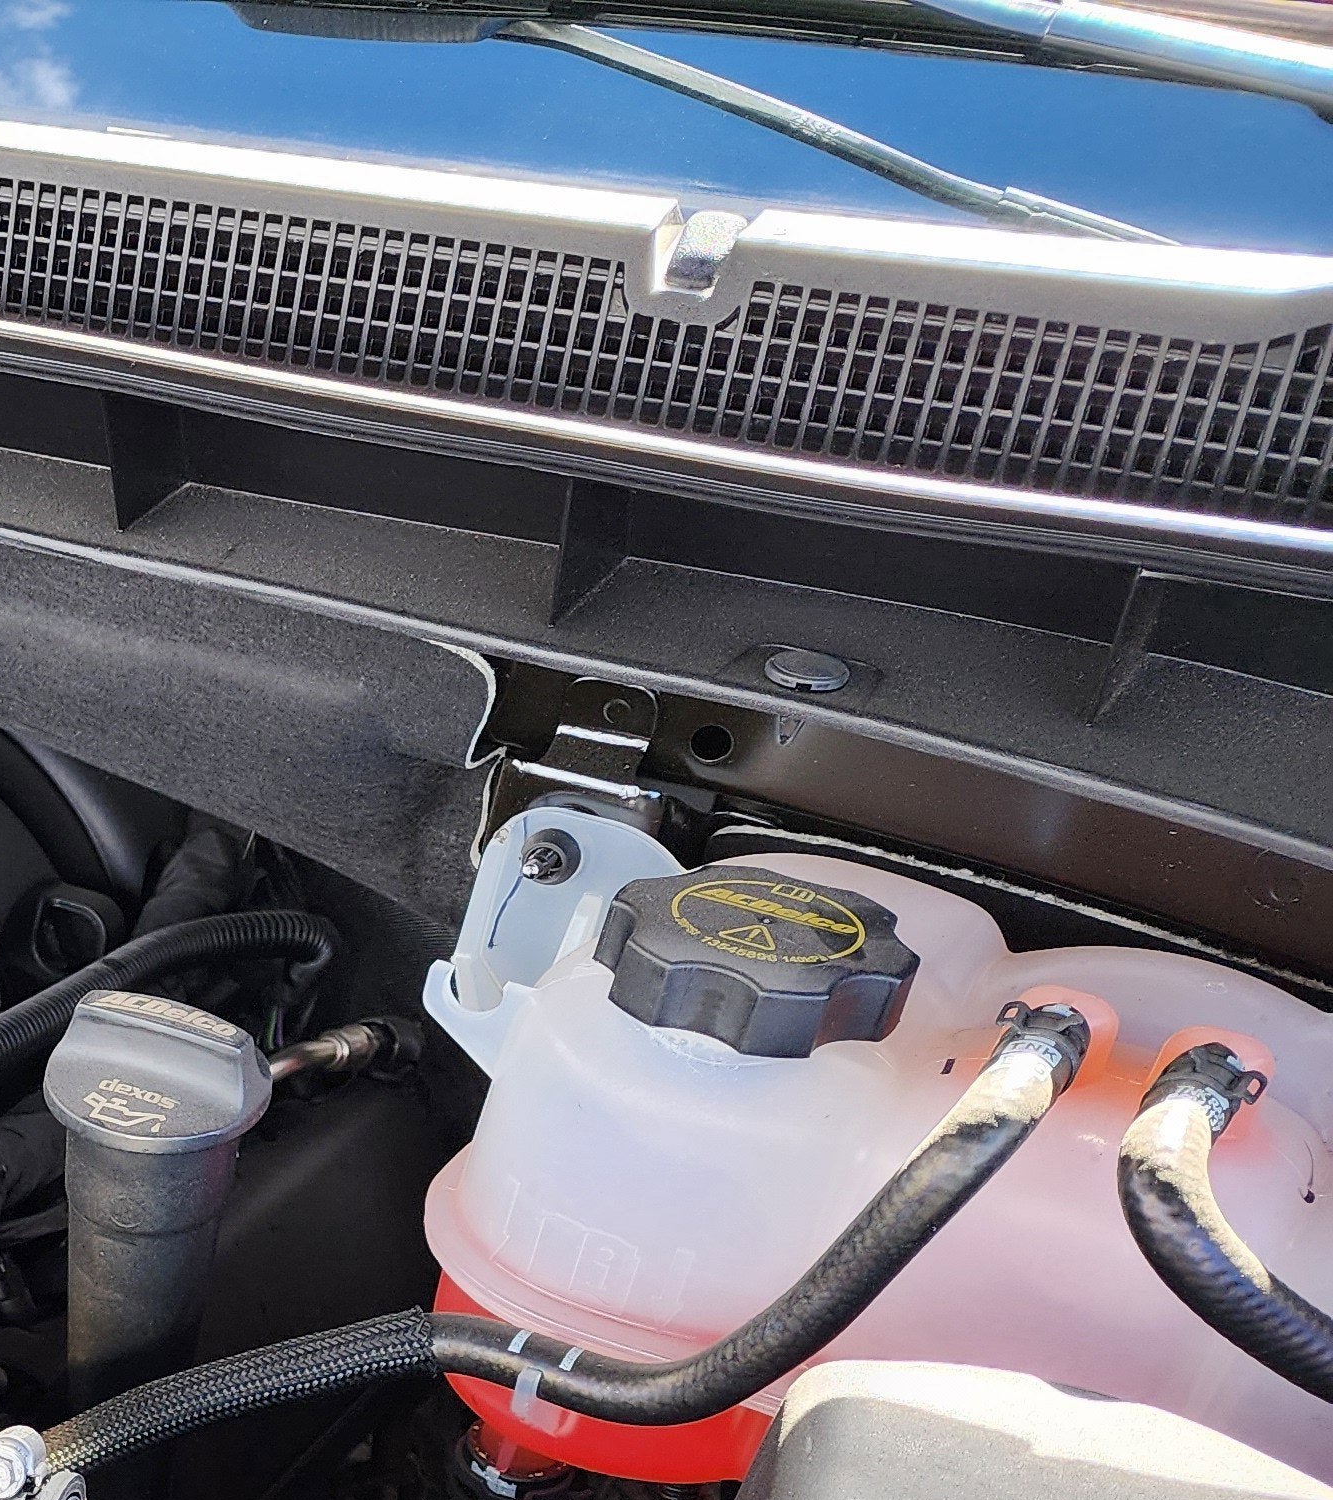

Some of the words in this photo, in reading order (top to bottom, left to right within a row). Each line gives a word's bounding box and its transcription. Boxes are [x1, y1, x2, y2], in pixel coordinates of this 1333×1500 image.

[690, 888, 858, 934] ACDelco
[90, 992, 237, 1037] ACDelco
[1010, 1041, 1057, 1064] TNK
[98, 1078, 180, 1110] dexos
